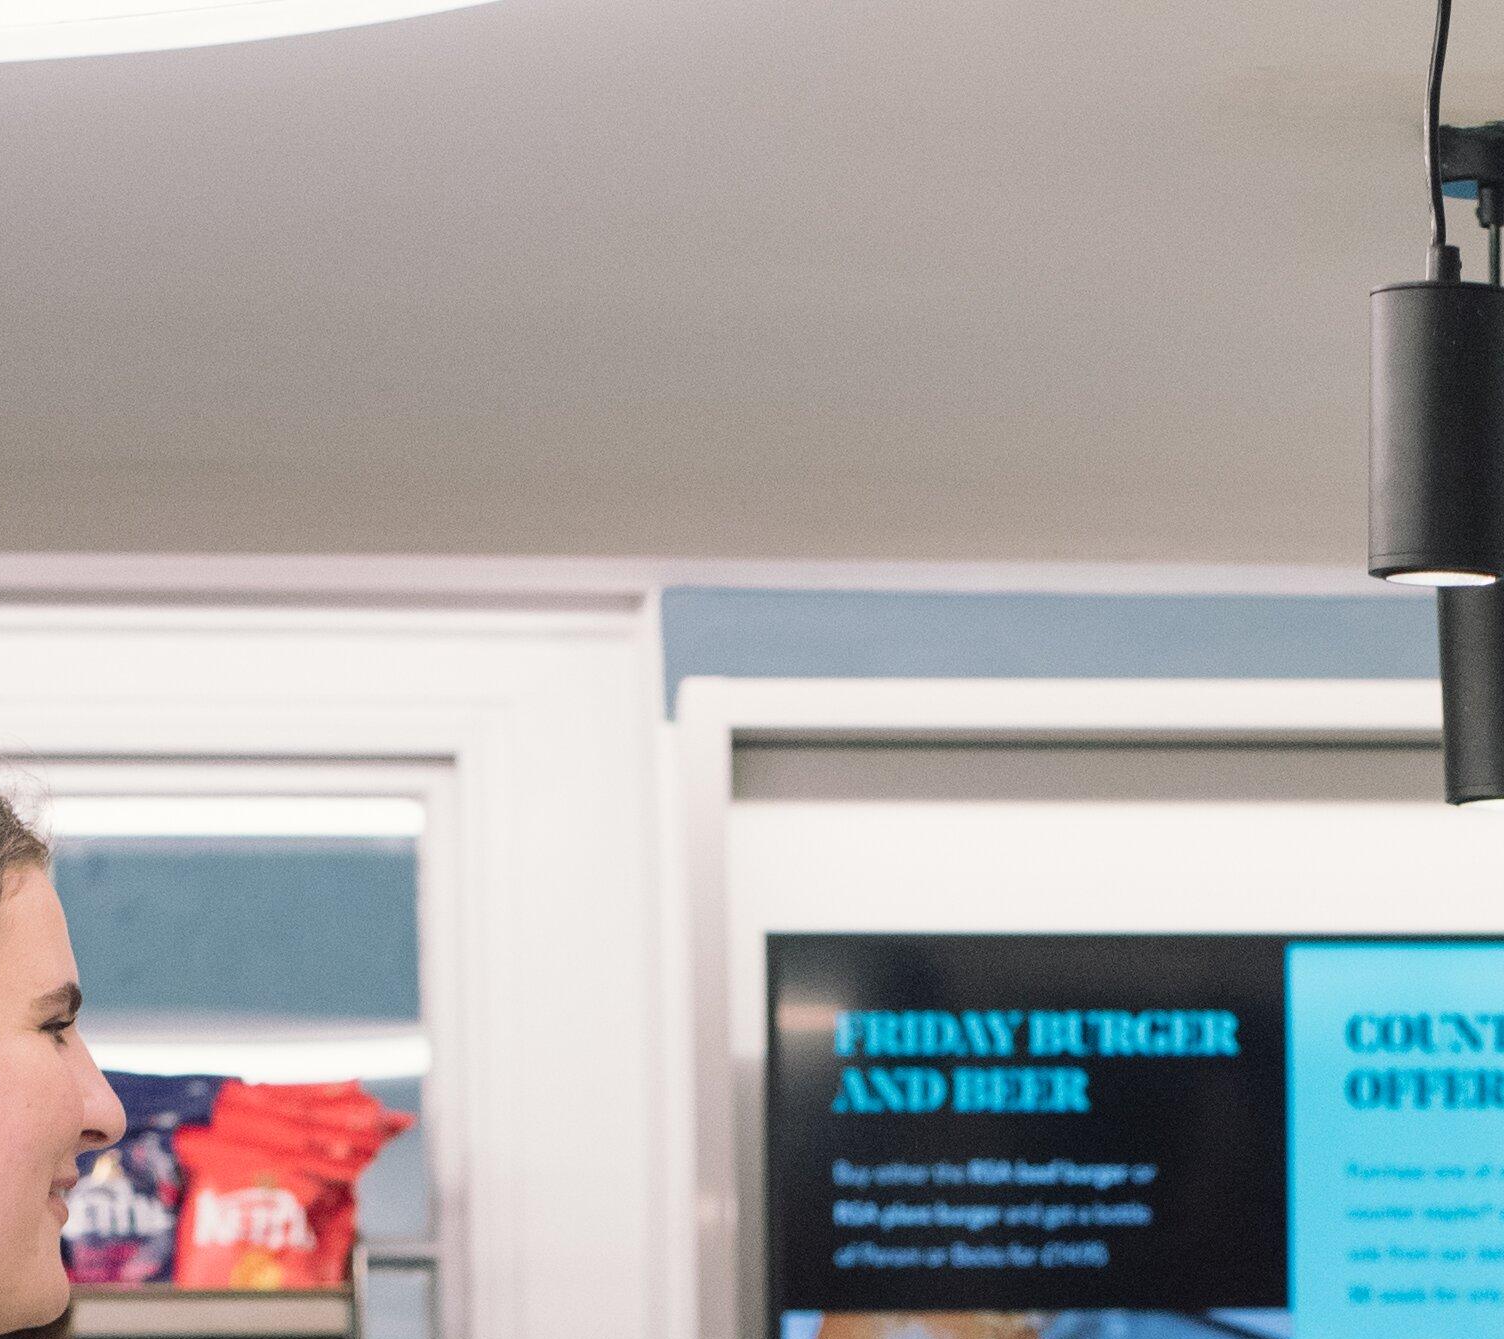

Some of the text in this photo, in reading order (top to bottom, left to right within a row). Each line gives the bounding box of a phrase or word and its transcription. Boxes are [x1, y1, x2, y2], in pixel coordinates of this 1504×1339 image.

[834, 1009, 1240, 1057] FRIDAY BURGER
[832, 1066, 1091, 1114] AND BEER
